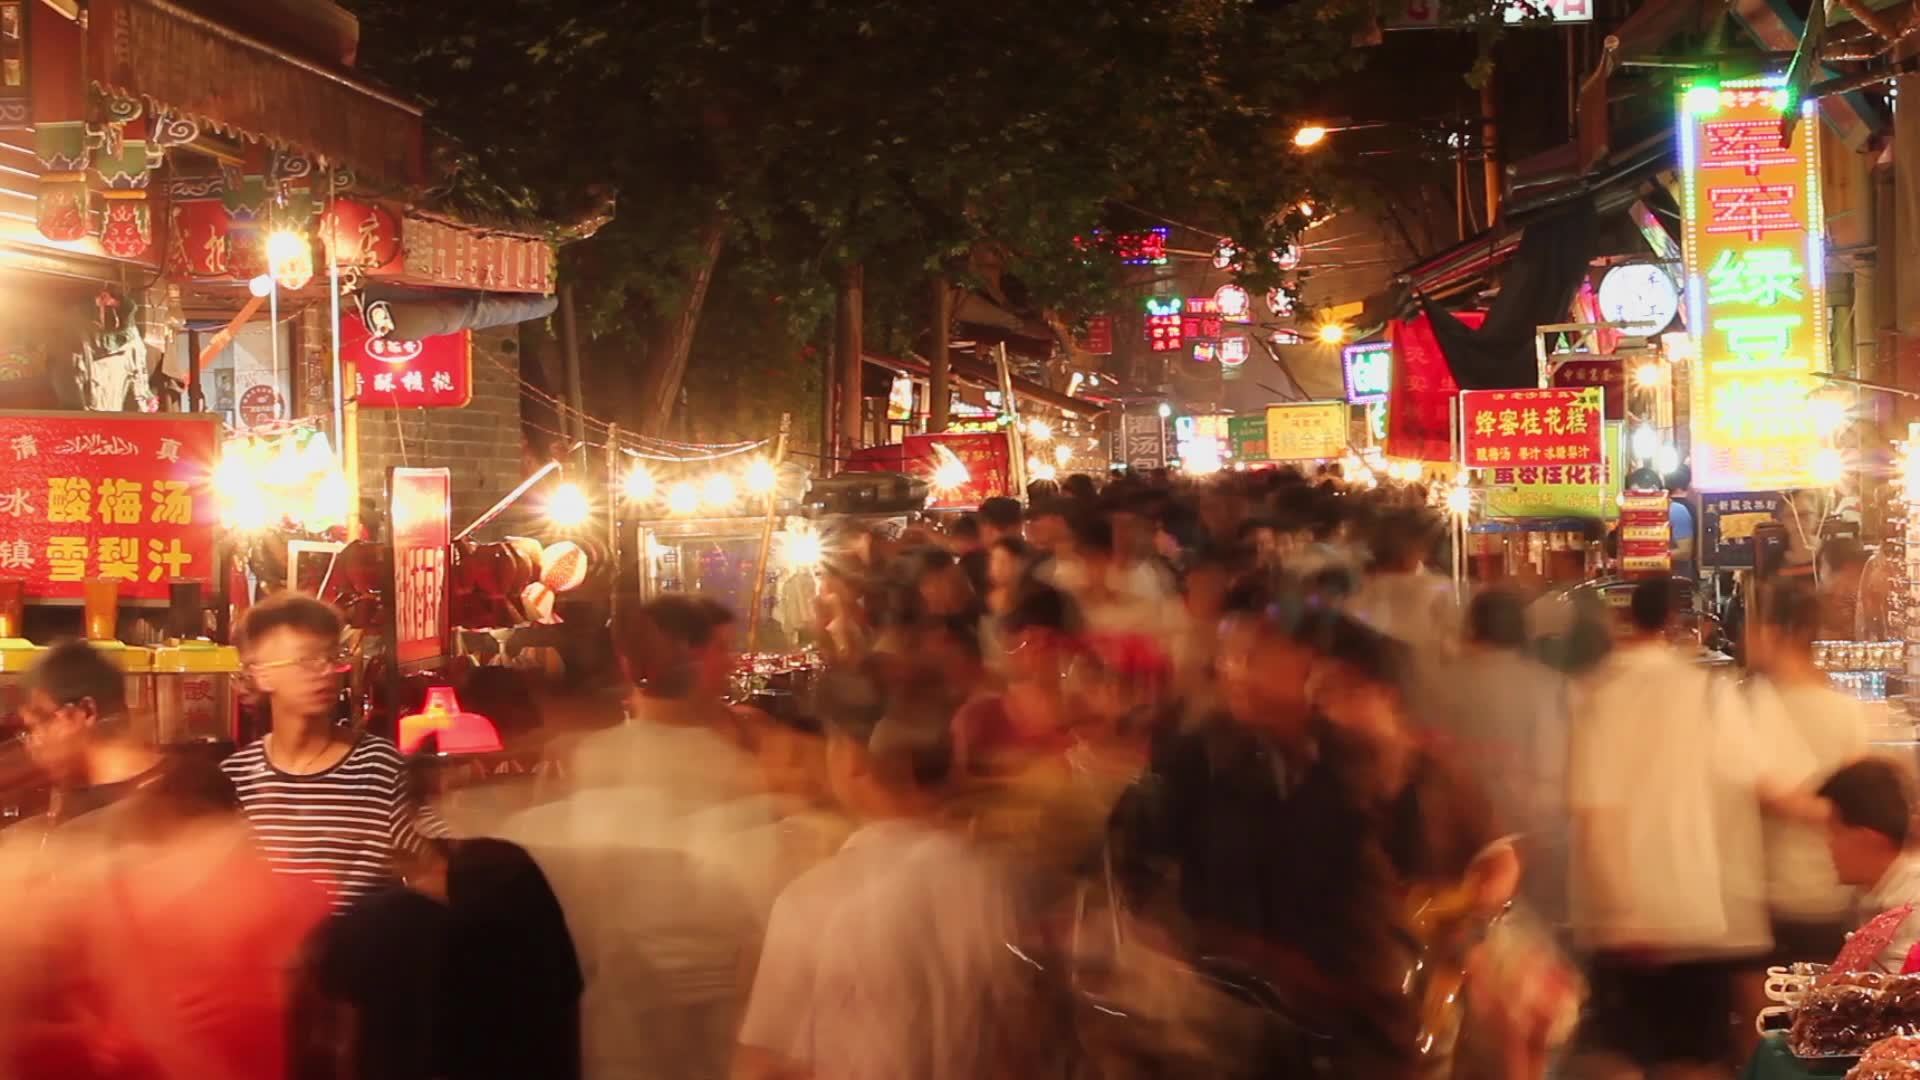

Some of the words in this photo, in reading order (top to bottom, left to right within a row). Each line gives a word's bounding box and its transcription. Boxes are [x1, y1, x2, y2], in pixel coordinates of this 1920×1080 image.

[1475, 407, 1589, 438] 蜂蜜桂花糕
[11, 434, 38, 461] 清
[156, 437, 183, 463] 真
[46, 477, 193, 525] 酸梅汤
[45, 536, 193, 583] 雪梨汁
